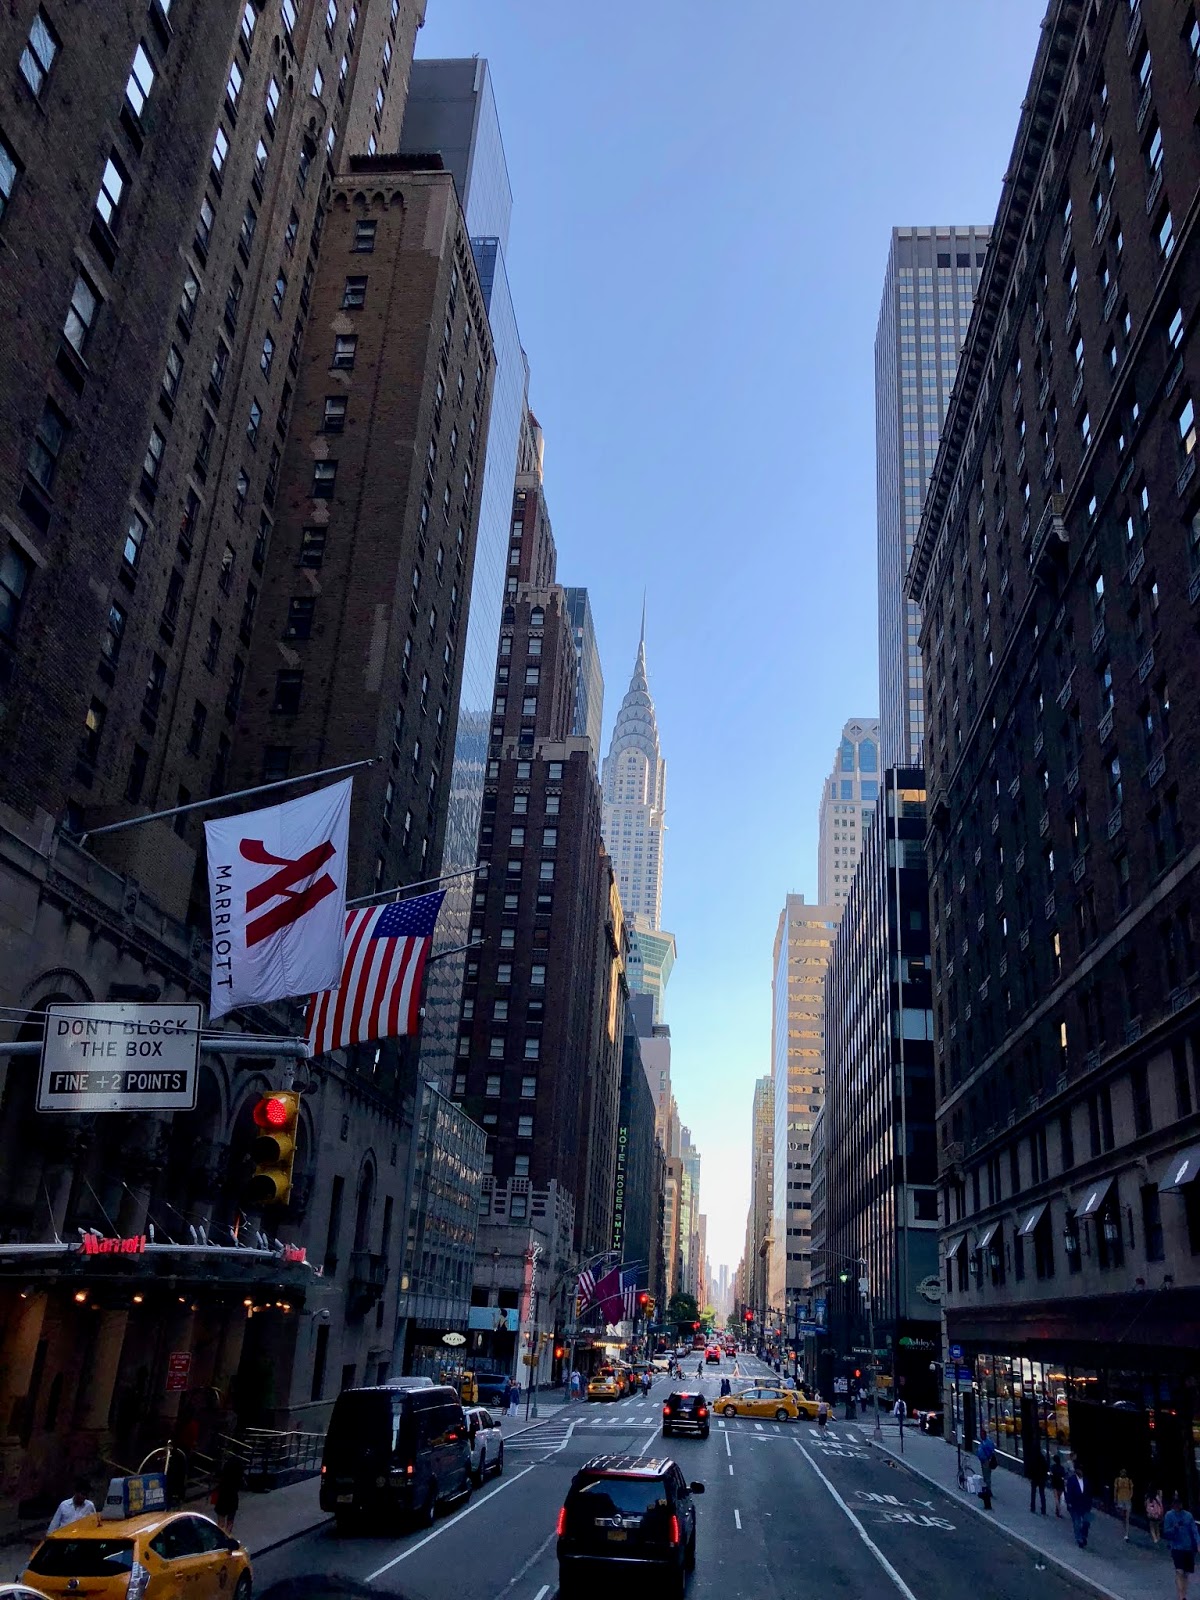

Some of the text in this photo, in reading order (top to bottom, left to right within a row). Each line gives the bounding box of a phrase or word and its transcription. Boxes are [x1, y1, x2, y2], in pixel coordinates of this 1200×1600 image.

[215, 865, 234, 989] MARRIOTT
[57, 1019, 188, 1036] DON'T BLOCK
[80, 1041, 163, 1057] THE BOX
[54, 1073, 181, 1091] FINE +2 POINTS
[613, 1127, 627, 1249] HOTEL ROGER SMITH
[77, 1232, 147, 1255] Marriott
[821, 1448, 871, 1460] BUS
[854, 1490, 936, 1511] ONLY
[874, 1511, 957, 1531] BUS
